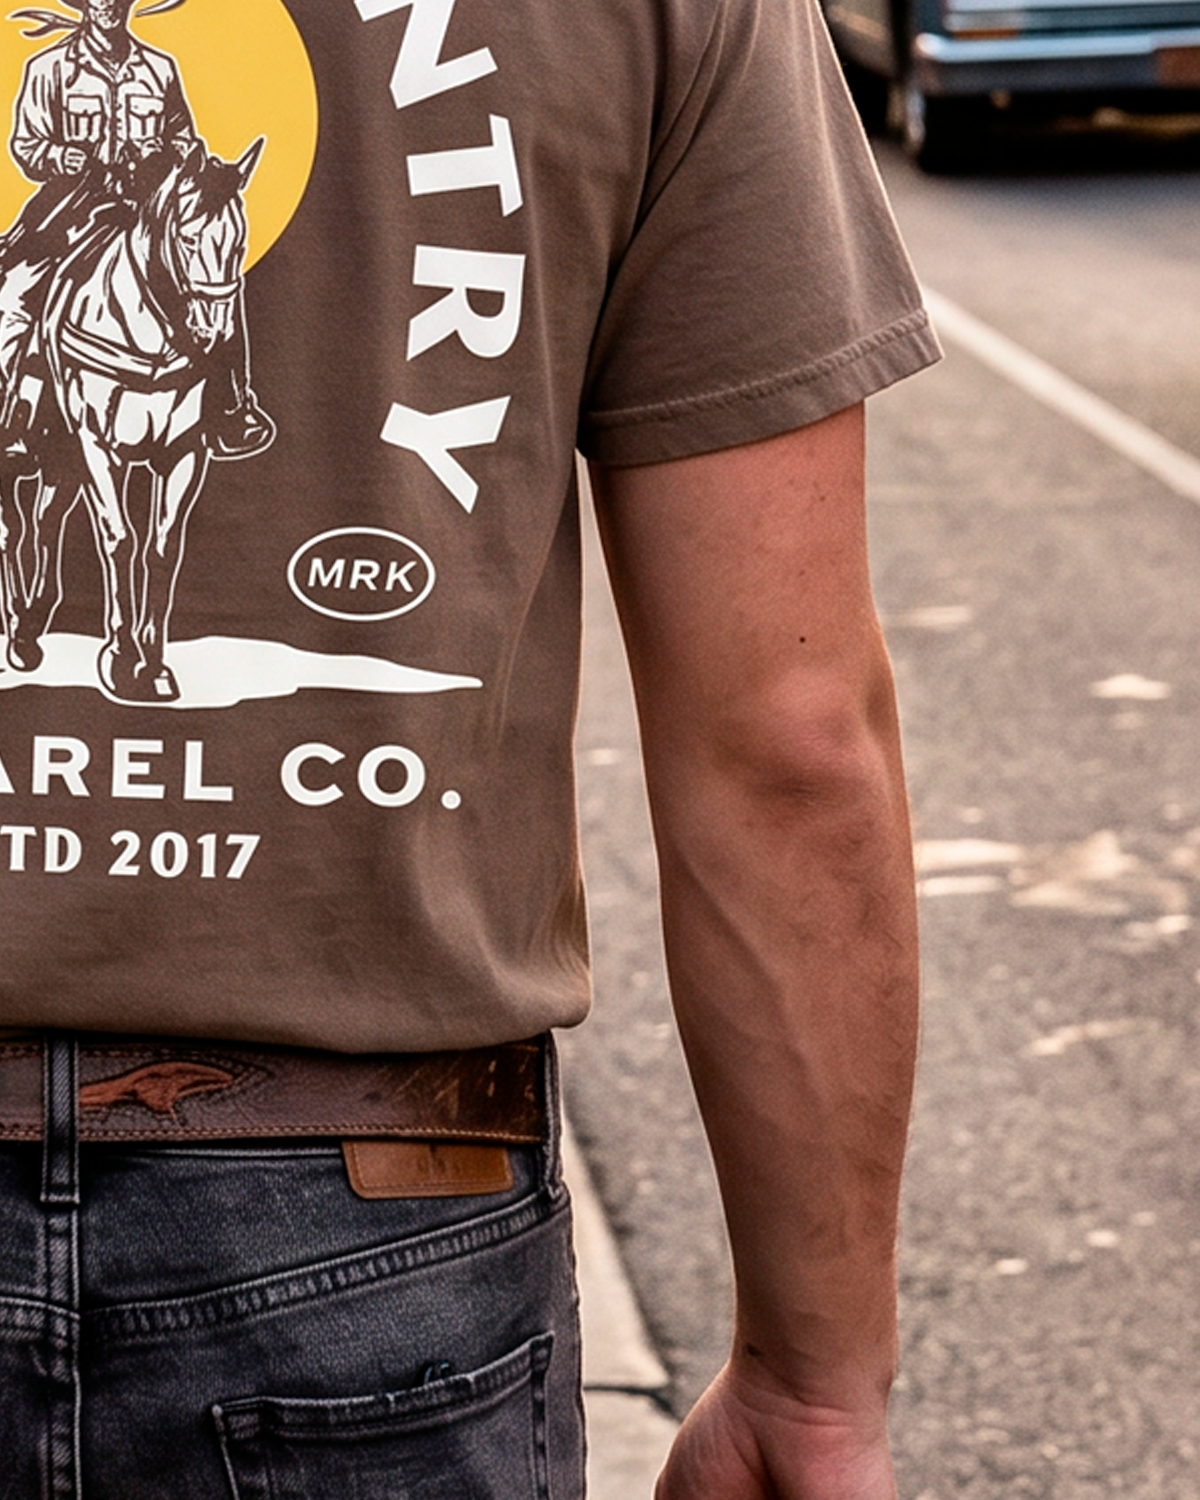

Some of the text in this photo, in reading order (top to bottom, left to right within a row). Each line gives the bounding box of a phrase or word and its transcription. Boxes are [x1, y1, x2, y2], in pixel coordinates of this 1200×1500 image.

[306, 556, 418, 594] MRK
[280, 741, 463, 811] CO.
[107, 830, 262, 880] 2017
